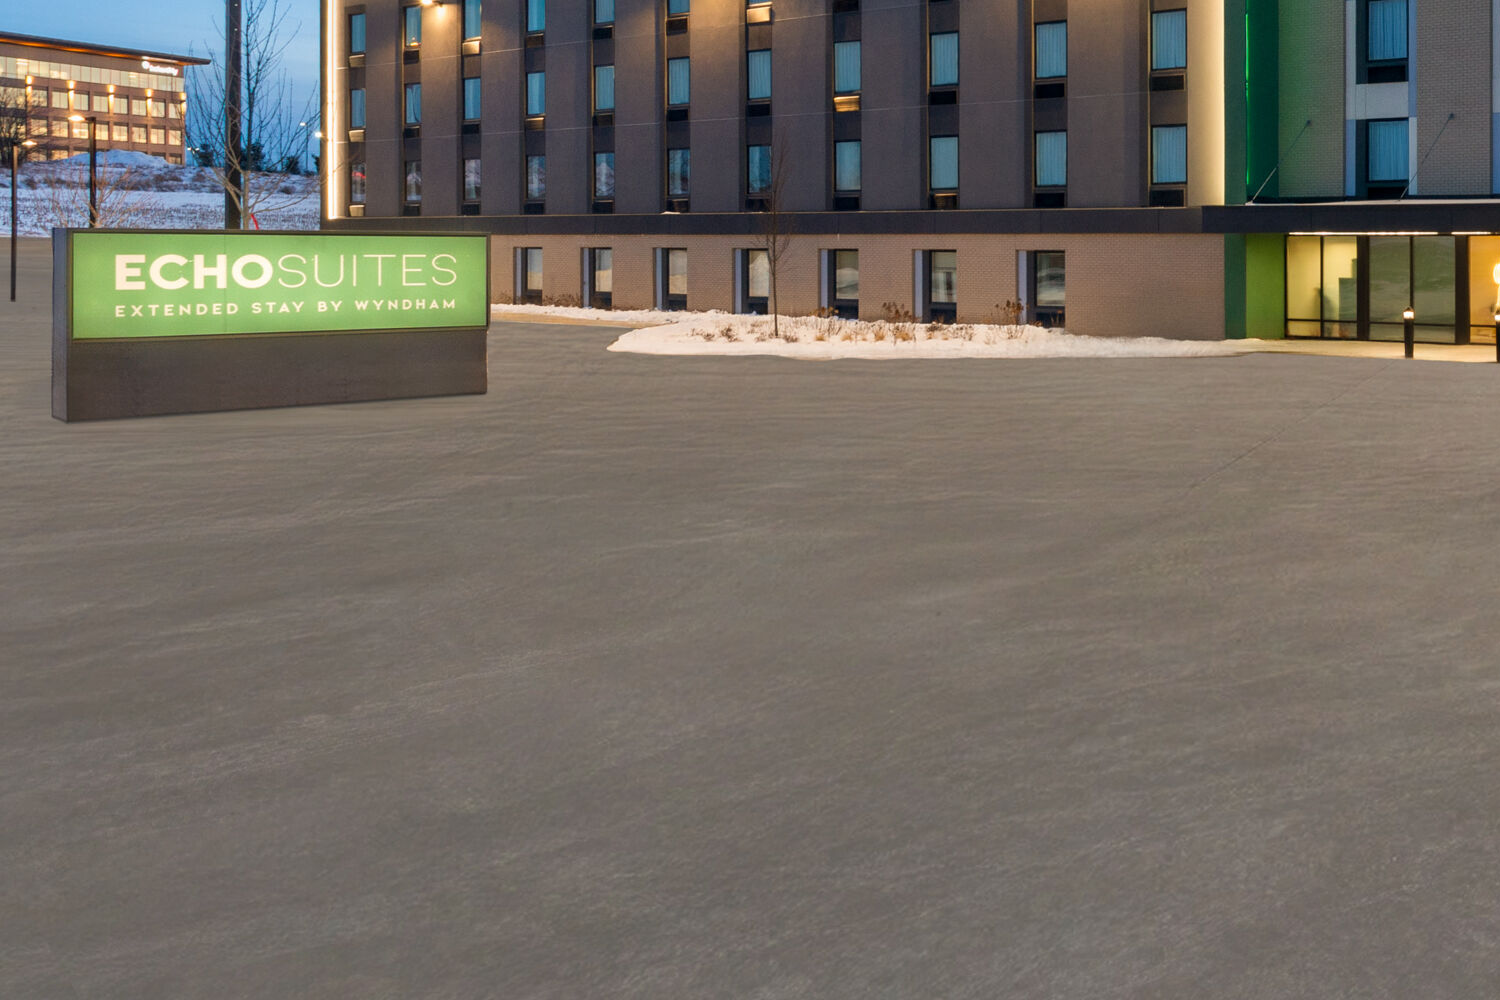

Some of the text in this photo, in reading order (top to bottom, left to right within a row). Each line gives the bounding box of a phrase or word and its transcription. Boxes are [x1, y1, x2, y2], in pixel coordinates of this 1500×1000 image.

[115, 298, 457, 318] EXTENDED STAY BY WYNDHAM
